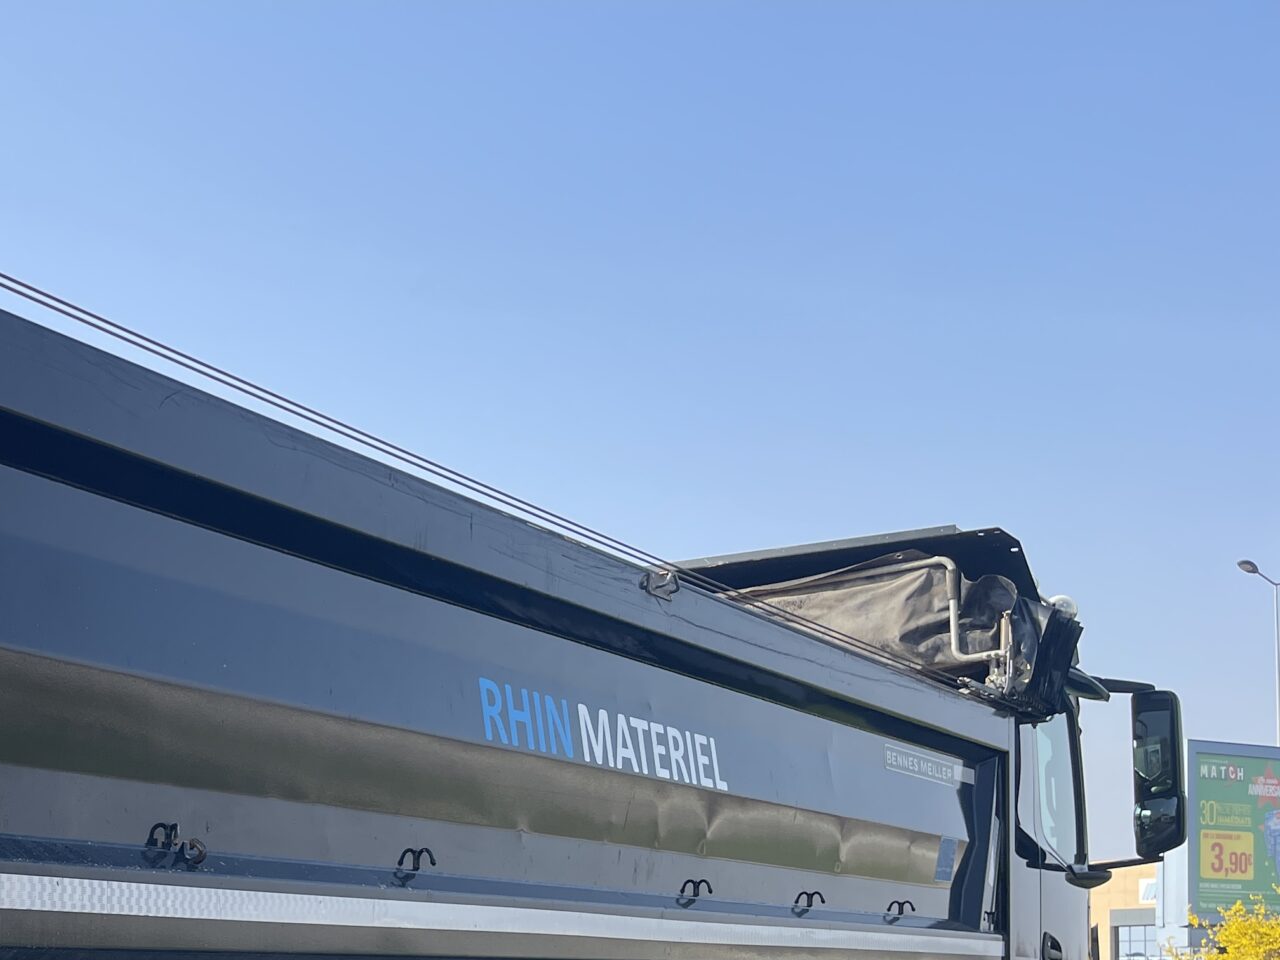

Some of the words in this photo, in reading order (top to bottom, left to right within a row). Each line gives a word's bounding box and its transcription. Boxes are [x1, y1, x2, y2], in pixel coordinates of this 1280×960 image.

[478, 676, 574, 759] RHIN
[577, 703, 729, 792] MATERIEL
[886, 750, 919, 772] BENNES
[920, 760, 952, 780] MEILLER
[1200, 764, 1244, 781] MATCH
